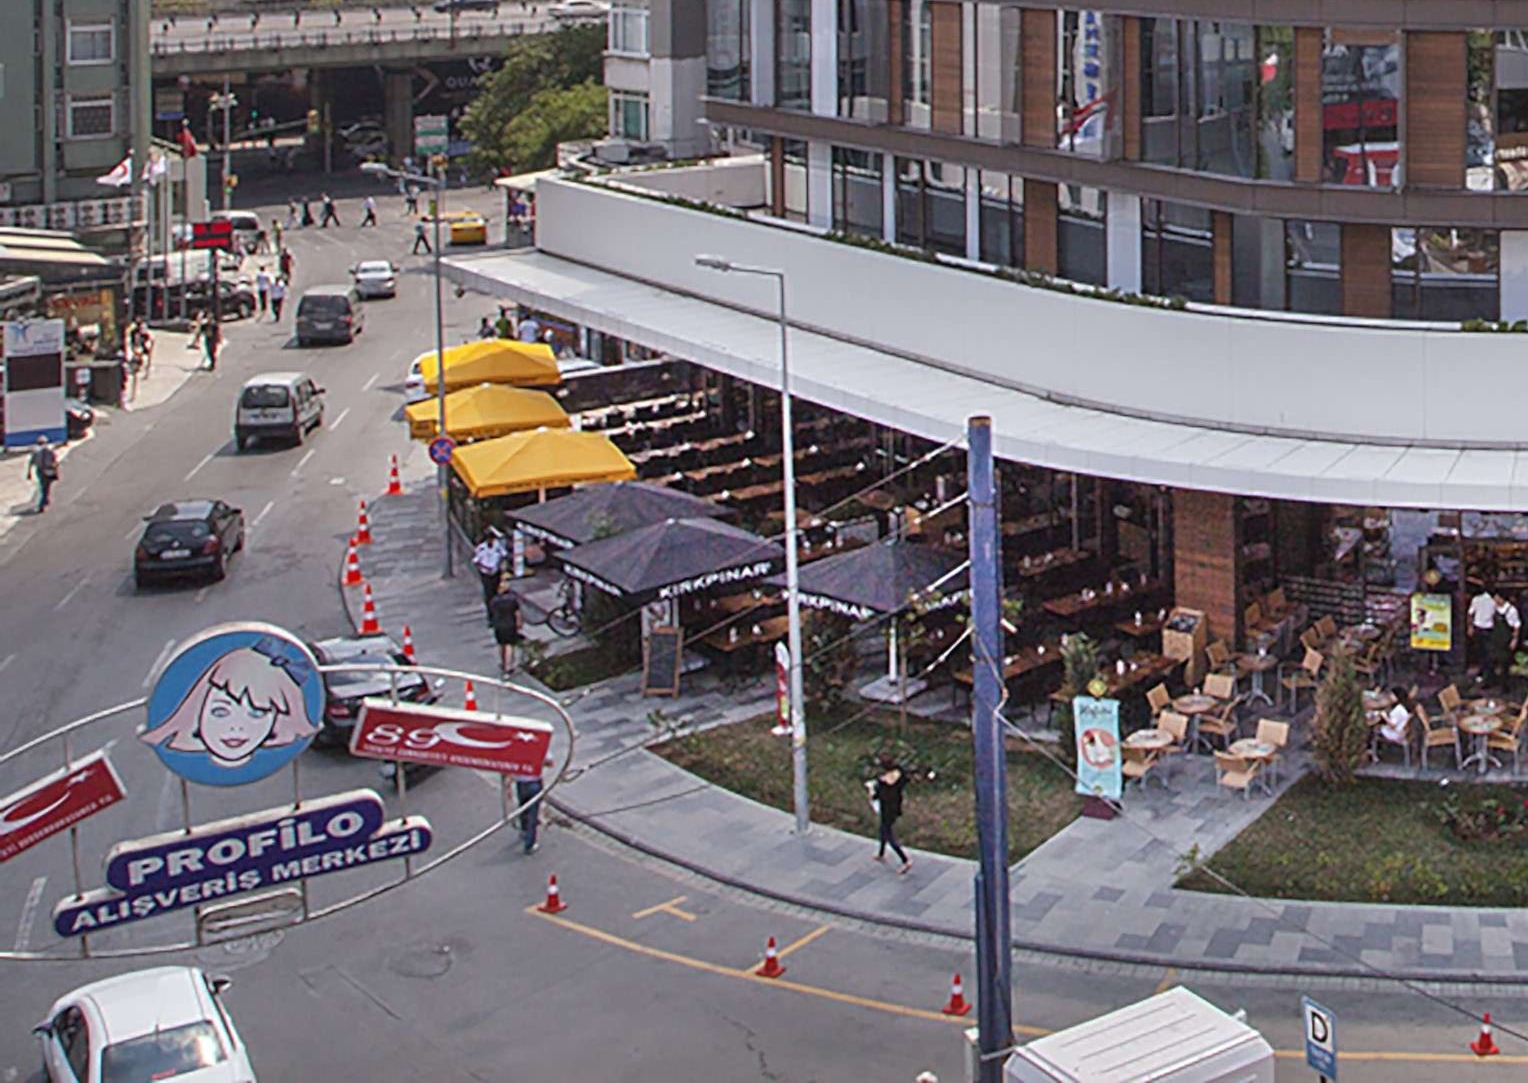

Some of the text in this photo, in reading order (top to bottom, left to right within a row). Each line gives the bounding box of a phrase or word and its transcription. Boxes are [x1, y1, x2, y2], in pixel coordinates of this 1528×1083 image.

[72, 831, 421, 932] ALIŞVERİŞ MERKEZİ
[128, 811, 364, 886] PROFİLO
[1311, 1010, 1328, 1043] D
